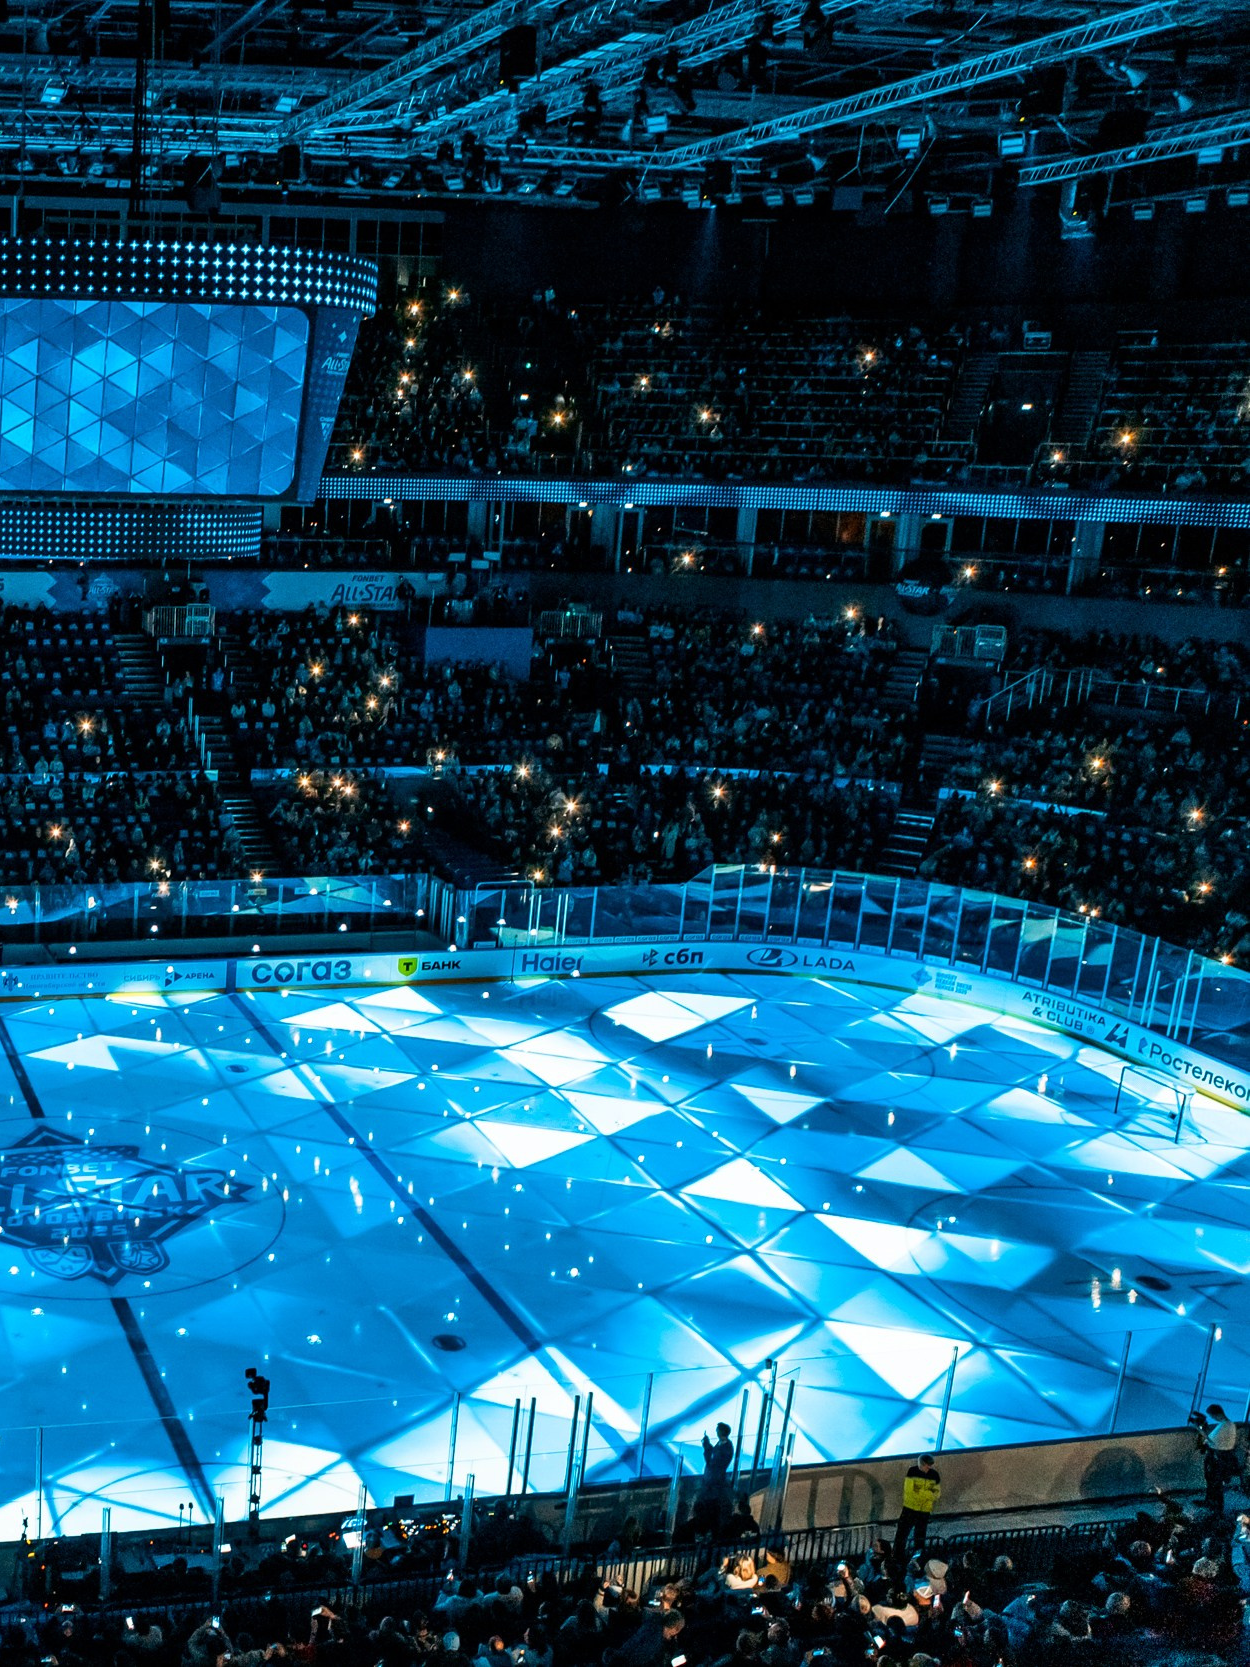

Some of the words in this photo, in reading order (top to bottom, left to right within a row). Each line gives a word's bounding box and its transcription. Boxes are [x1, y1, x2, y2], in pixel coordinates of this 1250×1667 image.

[421, 960, 461, 971] БАНК
[522, 952, 584, 972] Haier
[803, 955, 856, 972] LADA
[185, 972, 215, 980] АРЕНА
[1022, 991, 1106, 1026] ATRIBUTIKA
[1047, 1011, 1084, 1031] CLUB
[1150, 1042, 1250, 1101] Ростелеко
[0, 1161, 113, 1178] FONBET
[50, 1224, 129, 1240] 2025
